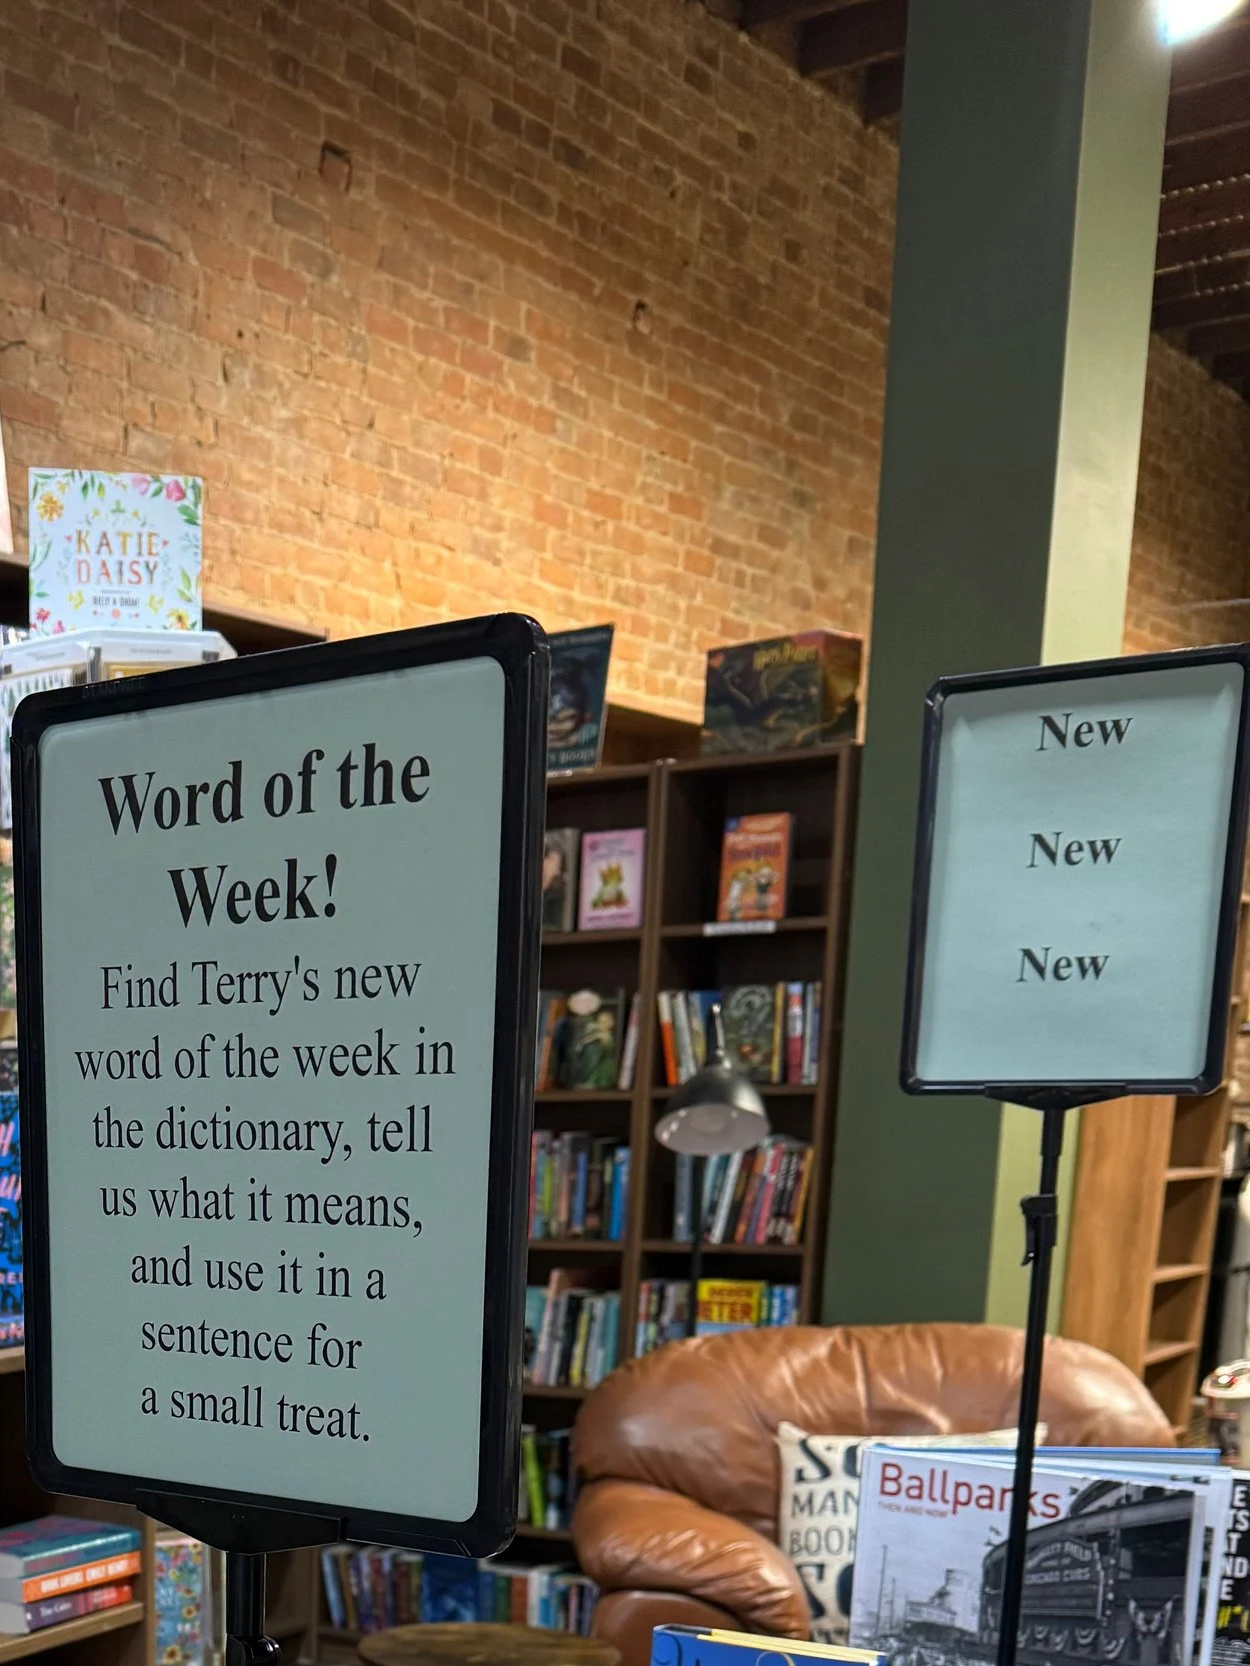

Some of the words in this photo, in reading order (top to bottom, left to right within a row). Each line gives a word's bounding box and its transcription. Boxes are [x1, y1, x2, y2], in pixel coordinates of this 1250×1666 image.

[76, 529, 160, 556] KATIE
[77, 559, 158, 585] DAISY
[1036, 713, 1134, 751] New
[98, 760, 244, 836] Word
[264, 749, 325, 818] of
[337, 742, 430, 810] the
[1026, 832, 1122, 868] New
[168, 854, 338, 928] Week!
[101, 962, 180, 1009] Find
[192, 955, 320, 1016] Terry's
[335, 963, 423, 1000] new
[1016, 947, 1110, 983] New
[74, 1035, 162, 1080] word
[174, 1033, 216, 1079] of
[223, 1033, 279, 1078] the
[293, 1028, 400, 1077] week
[415, 1026, 456, 1075] in
[93, 1105, 144, 1149] the
[156, 1105, 352, 1164] dictionary,
[367, 1104, 433, 1153] tell
[100, 1185, 137, 1217] us
[149, 1176, 236, 1221] what
[247, 1178, 272, 1222] it
[285, 1192, 422, 1238] means,
[131, 1245, 193, 1287] and
[204, 1259, 264, 1292] use
[277, 1250, 302, 1295] it
[316, 1252, 352, 1298] in
[366, 1268, 387, 1300] a
[142, 1319, 293, 1363] sentence
[307, 1323, 362, 1369] for
[141, 1385, 159, 1416] a
[170, 1385, 264, 1428] small
[277, 1394, 369, 1442] treat.
